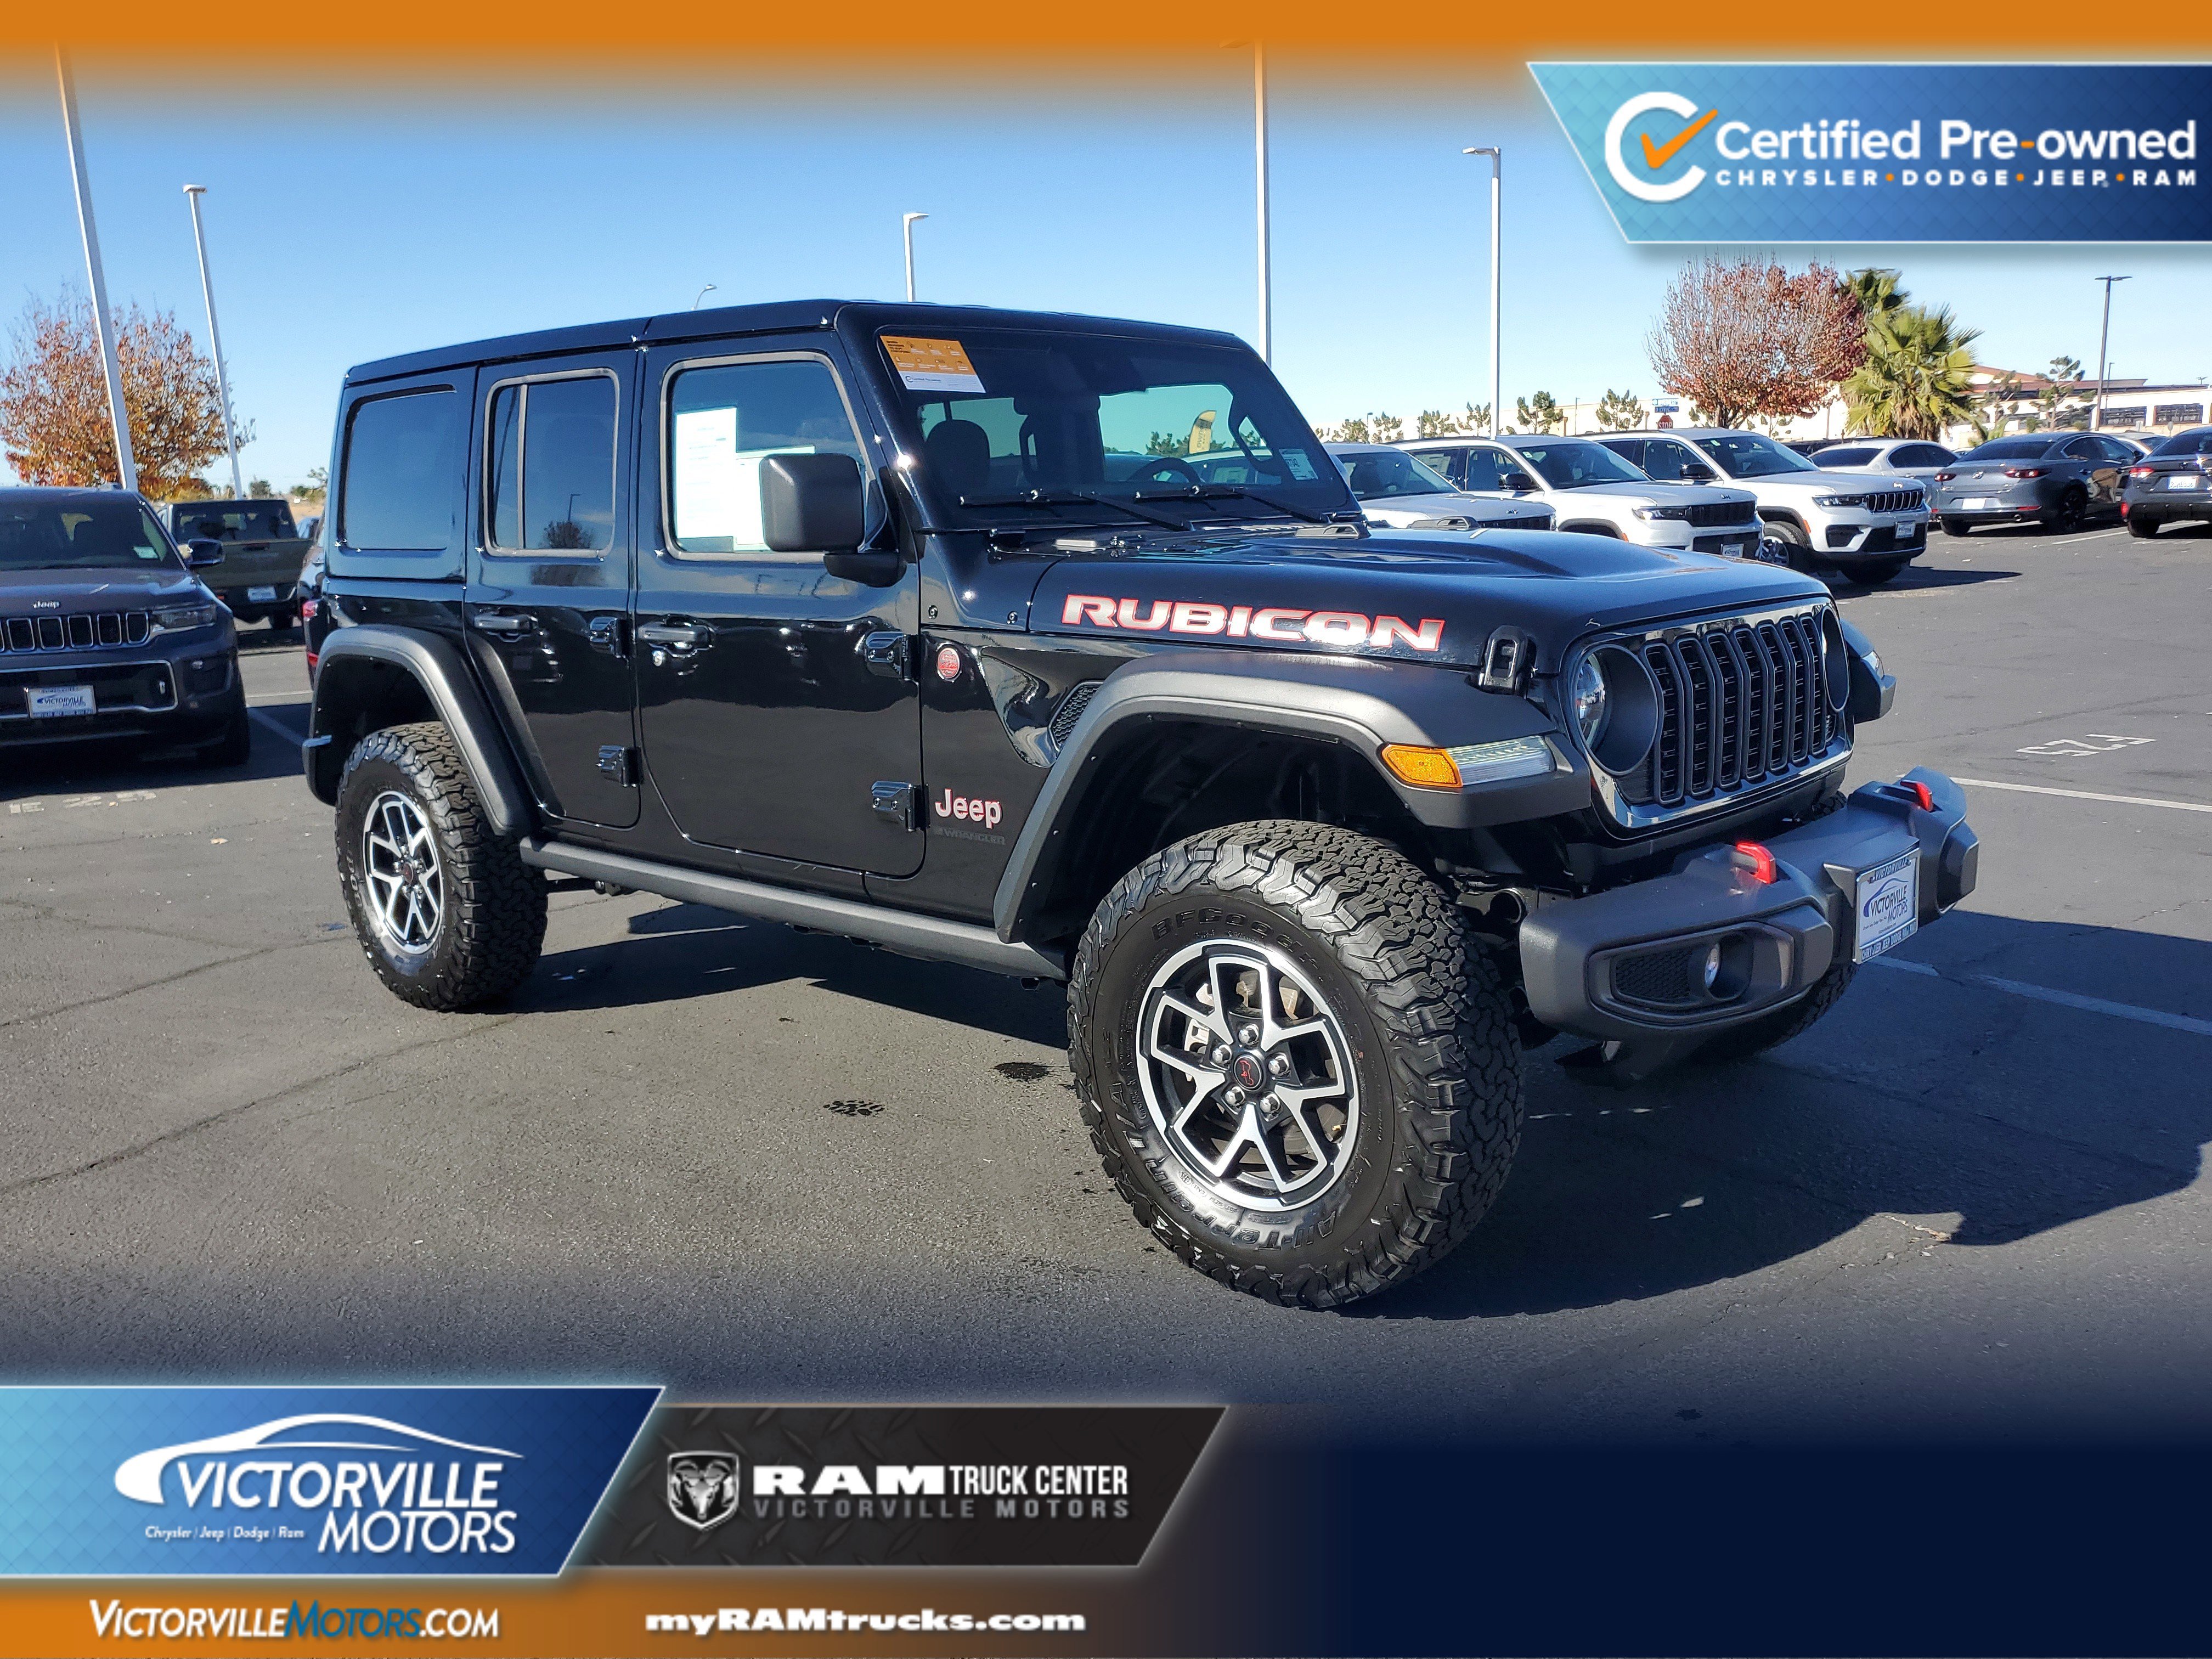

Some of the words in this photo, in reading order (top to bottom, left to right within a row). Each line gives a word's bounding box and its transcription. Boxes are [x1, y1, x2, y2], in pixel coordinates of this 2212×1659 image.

[1062, 594, 1445, 652] RUBICON
[935, 787, 1003, 830] Jeep
[1871, 884, 1908, 917] VICTORVILLE
